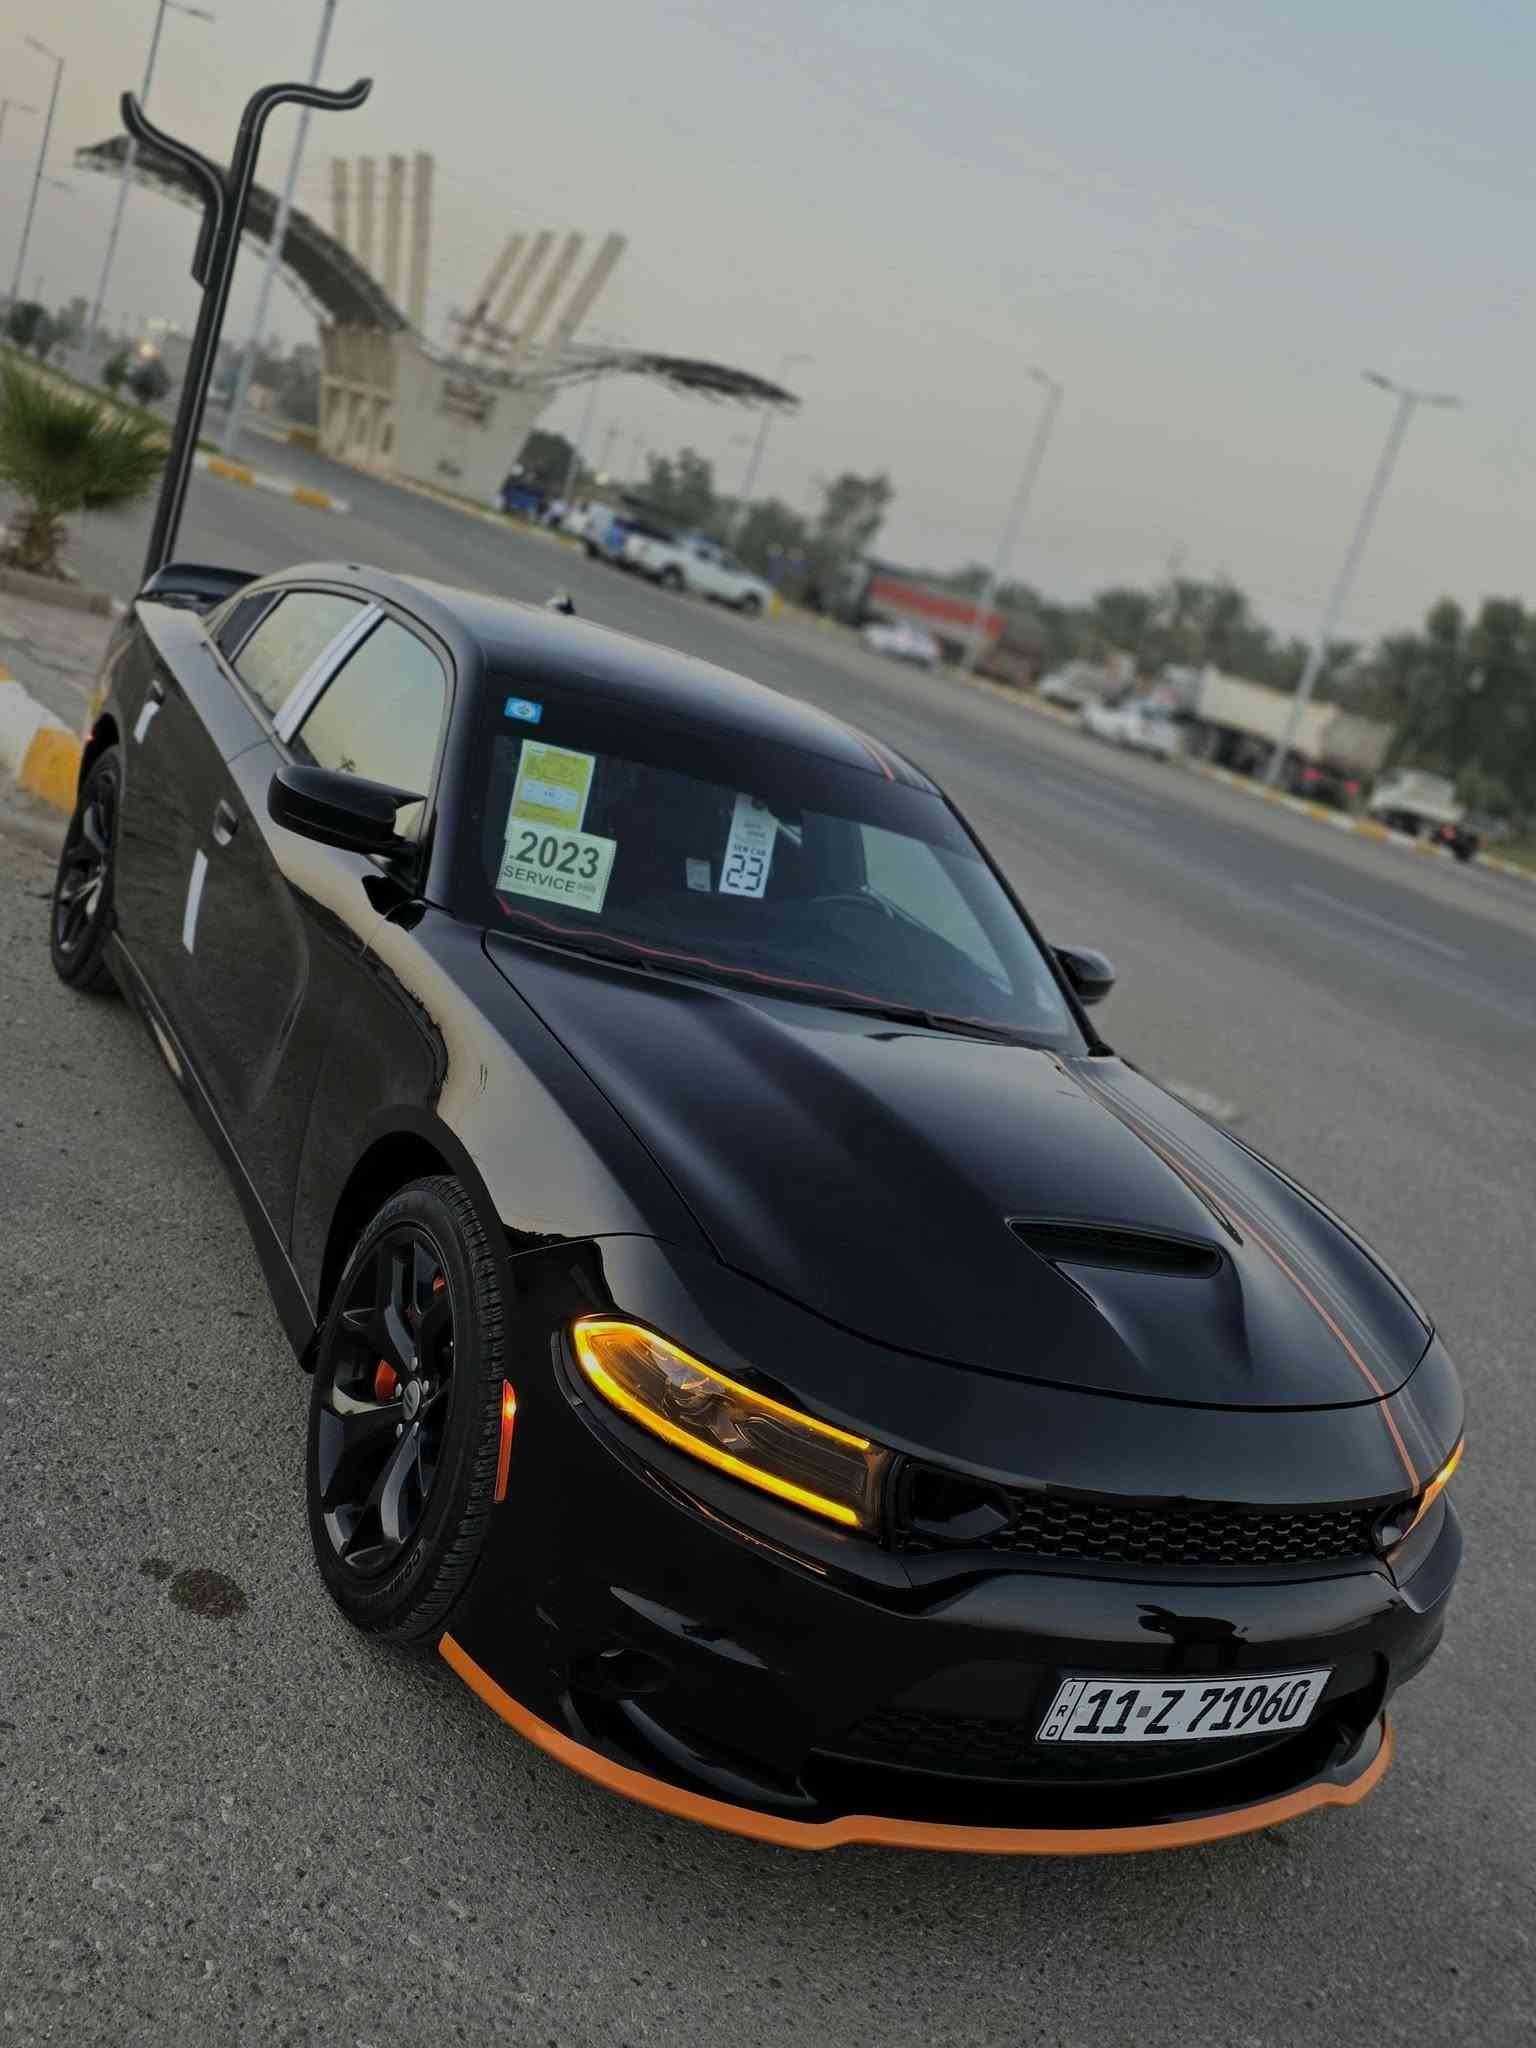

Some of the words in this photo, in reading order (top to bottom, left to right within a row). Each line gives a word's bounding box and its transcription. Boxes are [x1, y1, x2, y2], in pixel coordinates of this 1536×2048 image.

[516, 831, 599, 878] 2023
[503, 865, 577, 893] SERVICE
[1073, 1689, 1140, 1735] 11
[1186, 1679, 1311, 1733] 71960
